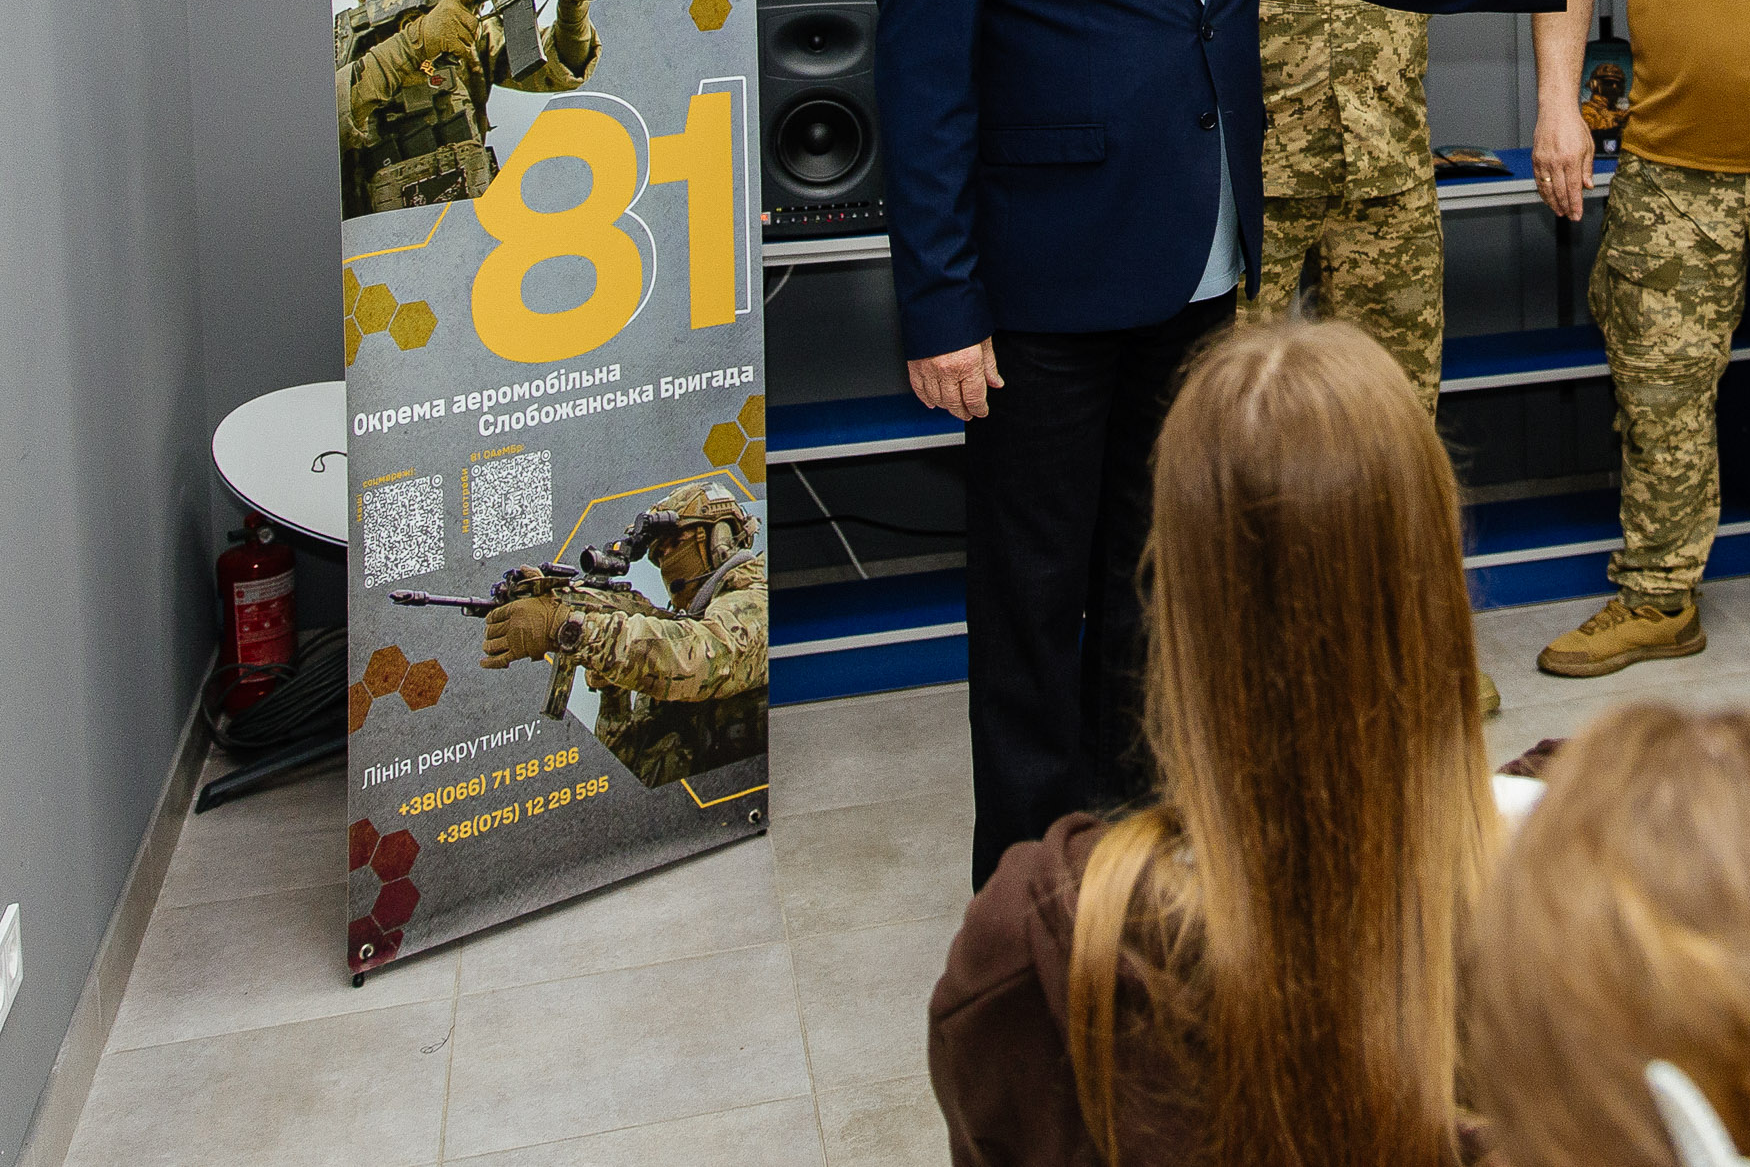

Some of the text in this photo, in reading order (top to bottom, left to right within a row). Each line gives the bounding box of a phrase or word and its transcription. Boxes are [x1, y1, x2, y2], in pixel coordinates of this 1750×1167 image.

[471, 77, 751, 363] 81
[353, 363, 621, 436] Окрема аеромобільна
[478, 365, 754, 437] Слобожанська Бригада
[361, 718, 542, 790] Лінія рекрутингу:
[398, 746, 580, 817] +38(066) 71 58 386
[437, 775, 609, 844] +38(075) 12 29 595
